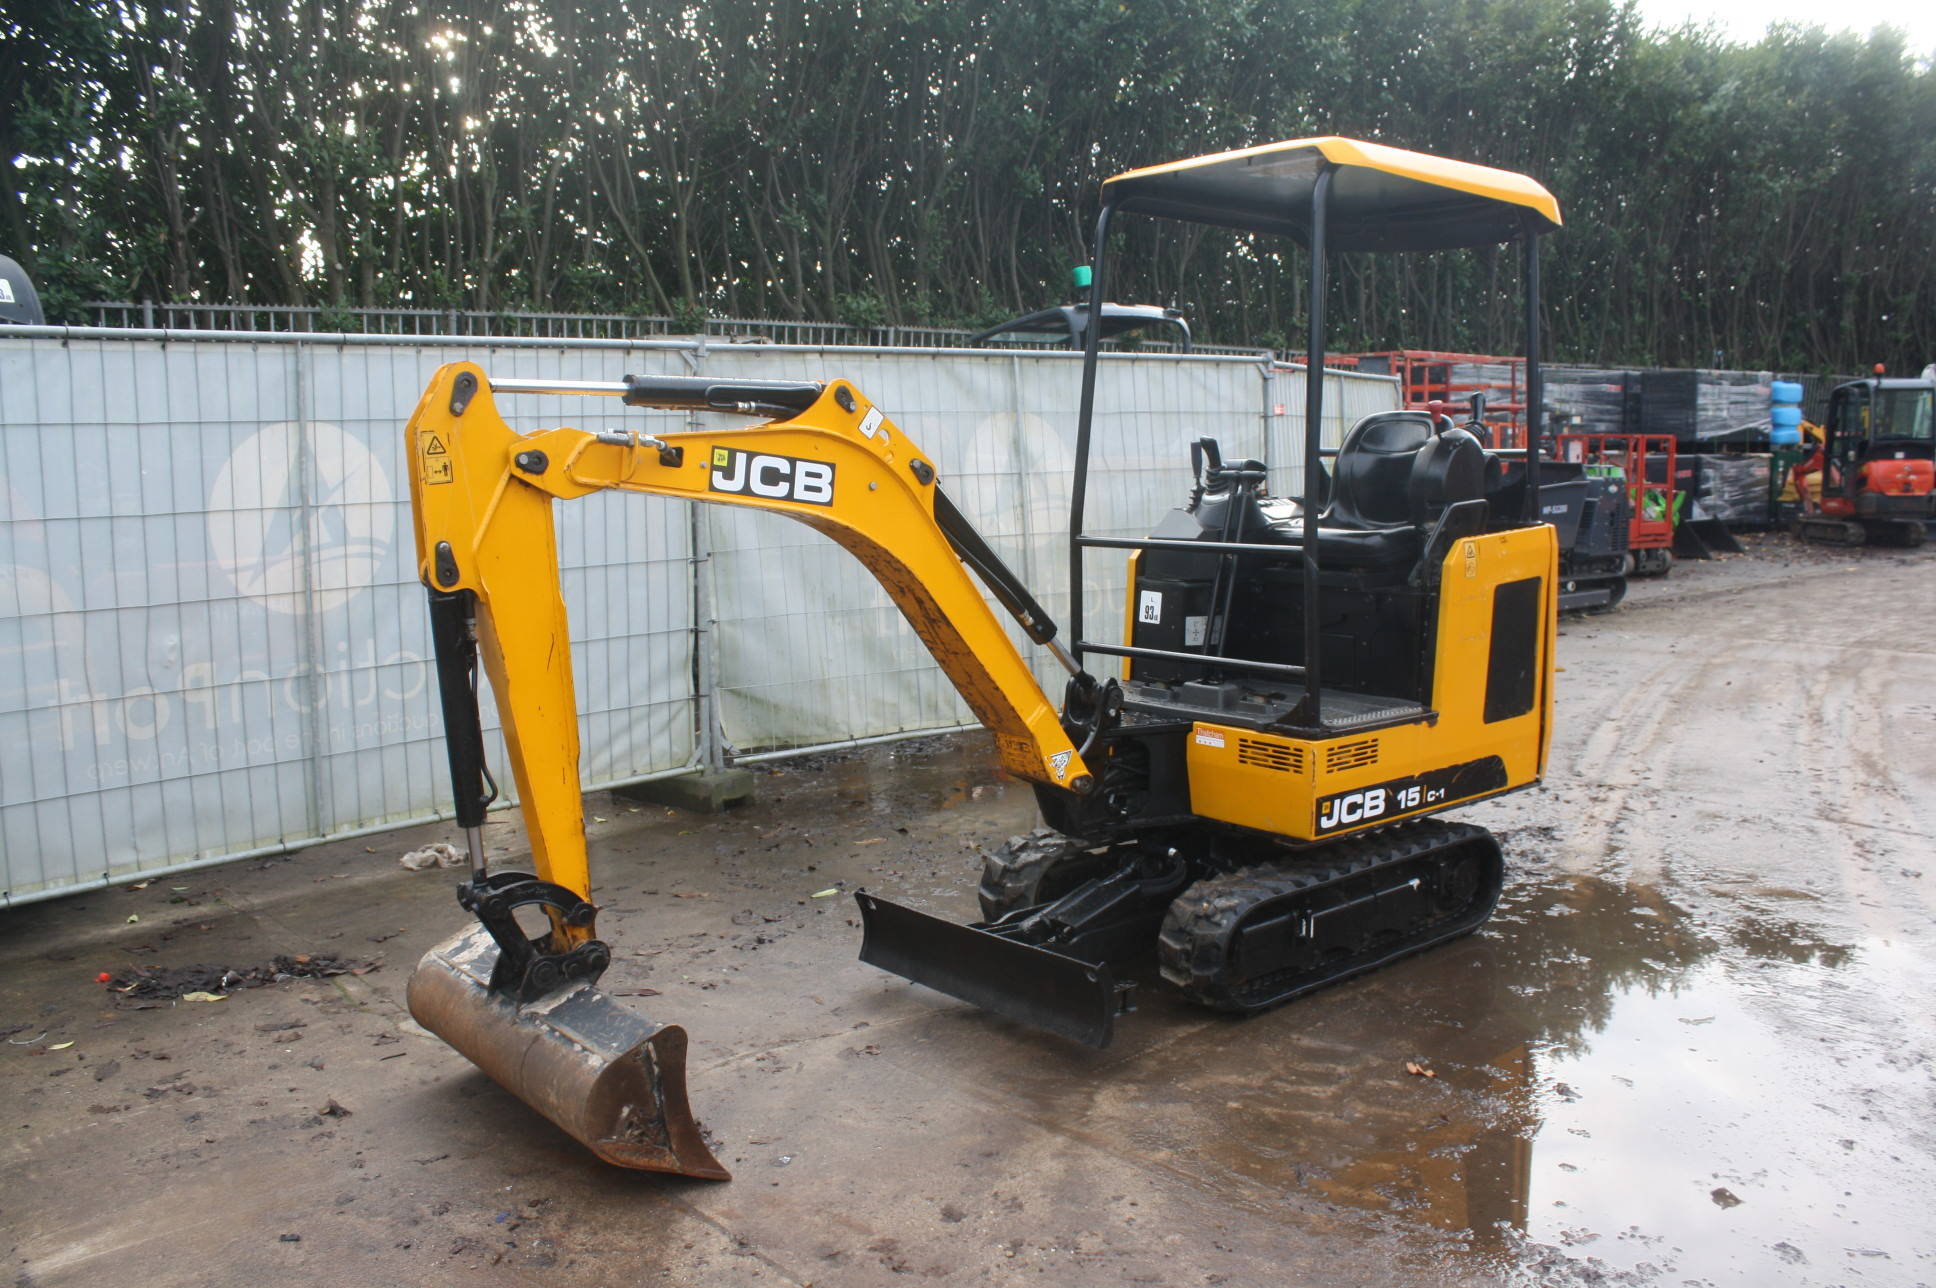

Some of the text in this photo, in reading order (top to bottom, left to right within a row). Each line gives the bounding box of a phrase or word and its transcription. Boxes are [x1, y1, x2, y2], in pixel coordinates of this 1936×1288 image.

[712, 451, 833, 503] JCB
[1144, 605, 1154, 620] 93
[1320, 786, 1446, 829] JCB 15 C-1
